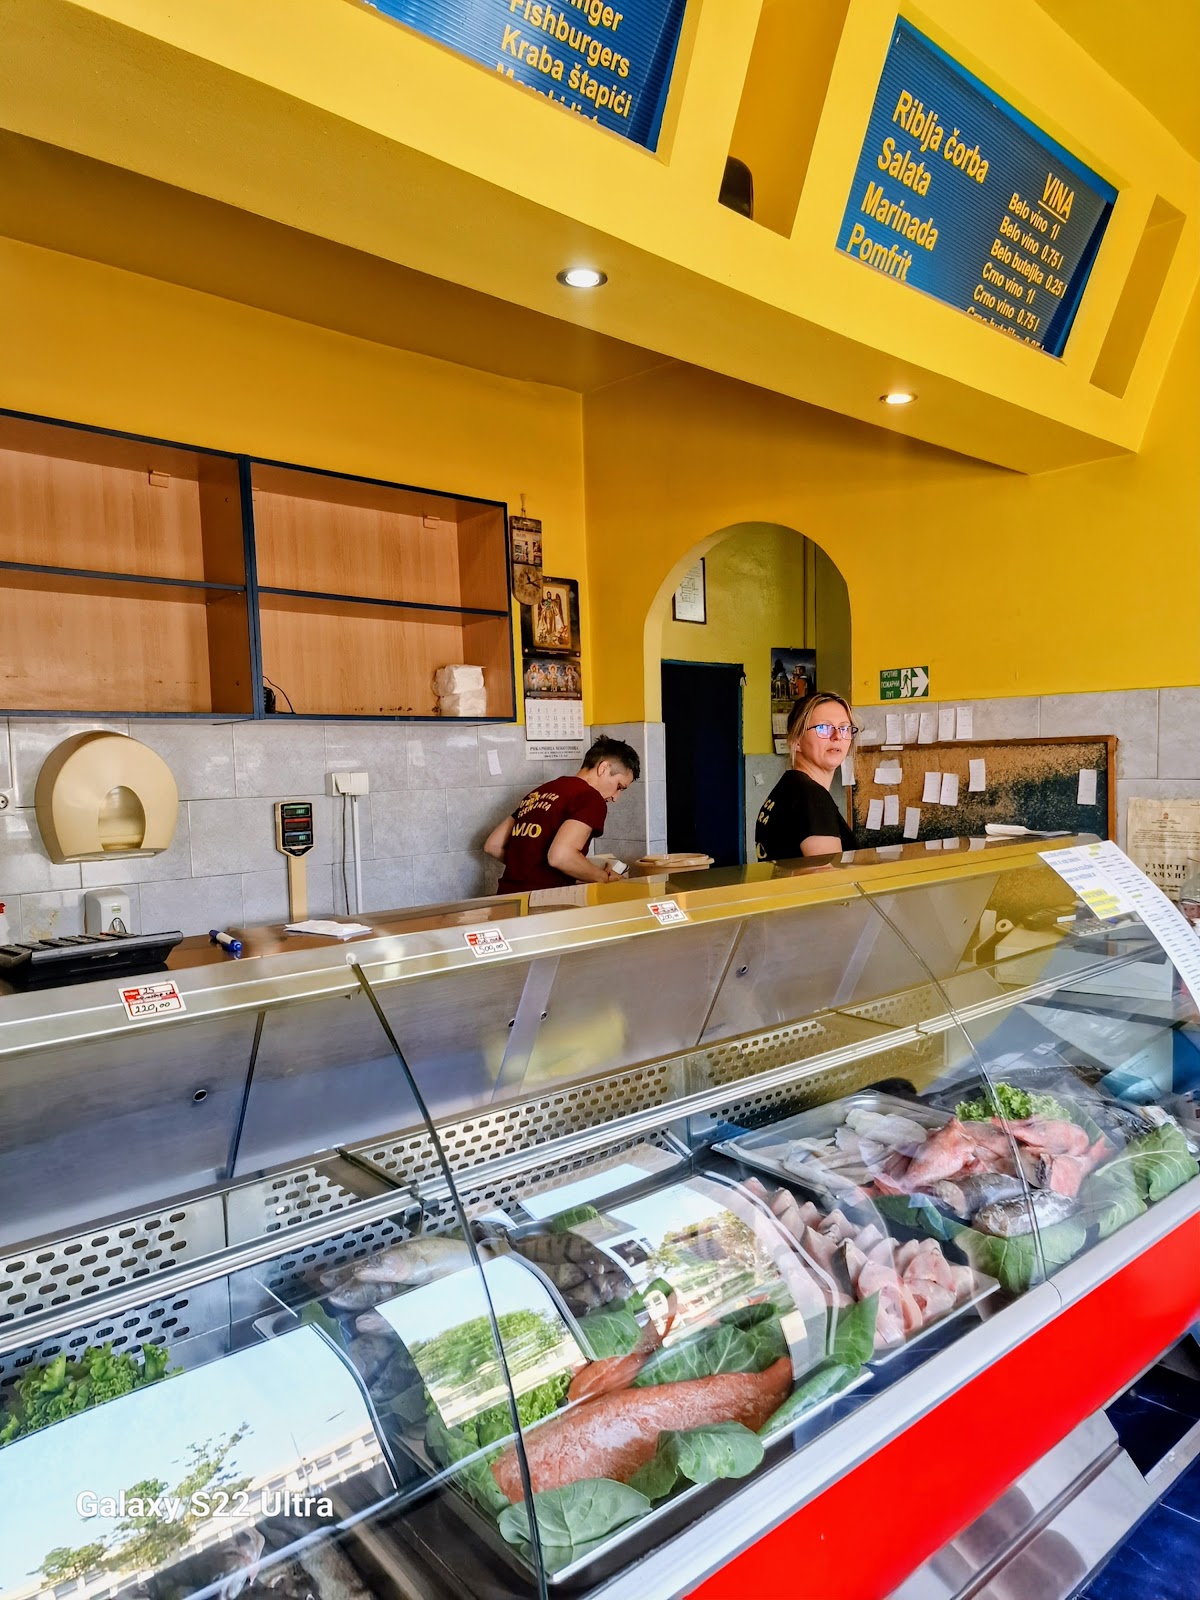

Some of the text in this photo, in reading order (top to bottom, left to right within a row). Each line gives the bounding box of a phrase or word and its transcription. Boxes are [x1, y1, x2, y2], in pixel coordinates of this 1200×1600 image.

[501, 24, 564, 80] Kraba
[568, 62, 633, 117] štapići
[892, 89, 989, 184] Riblja čorba
[877, 137, 931, 196] Salata
[860, 181, 939, 251] Marinada
[1008, 192, 1029, 219] Belo
[1030, 210, 1048, 233] vino
[1042, 172, 1074, 220] VINA
[846, 222, 912, 281] Pomfrit
[999, 215, 1020, 242] Belo
[1022, 233, 1039, 255] vino
[982, 262, 1003, 287] Crno
[1004, 277, 1023, 298] vino
[990, 239, 1012, 264] Belo
[1011, 251, 1044, 285] buteljka
[973, 284, 995, 308] Crno
[996, 299, 1015, 319] vino
[479, 944, 504, 954] 500,00
[135, 1002, 170, 1014] 220,00
